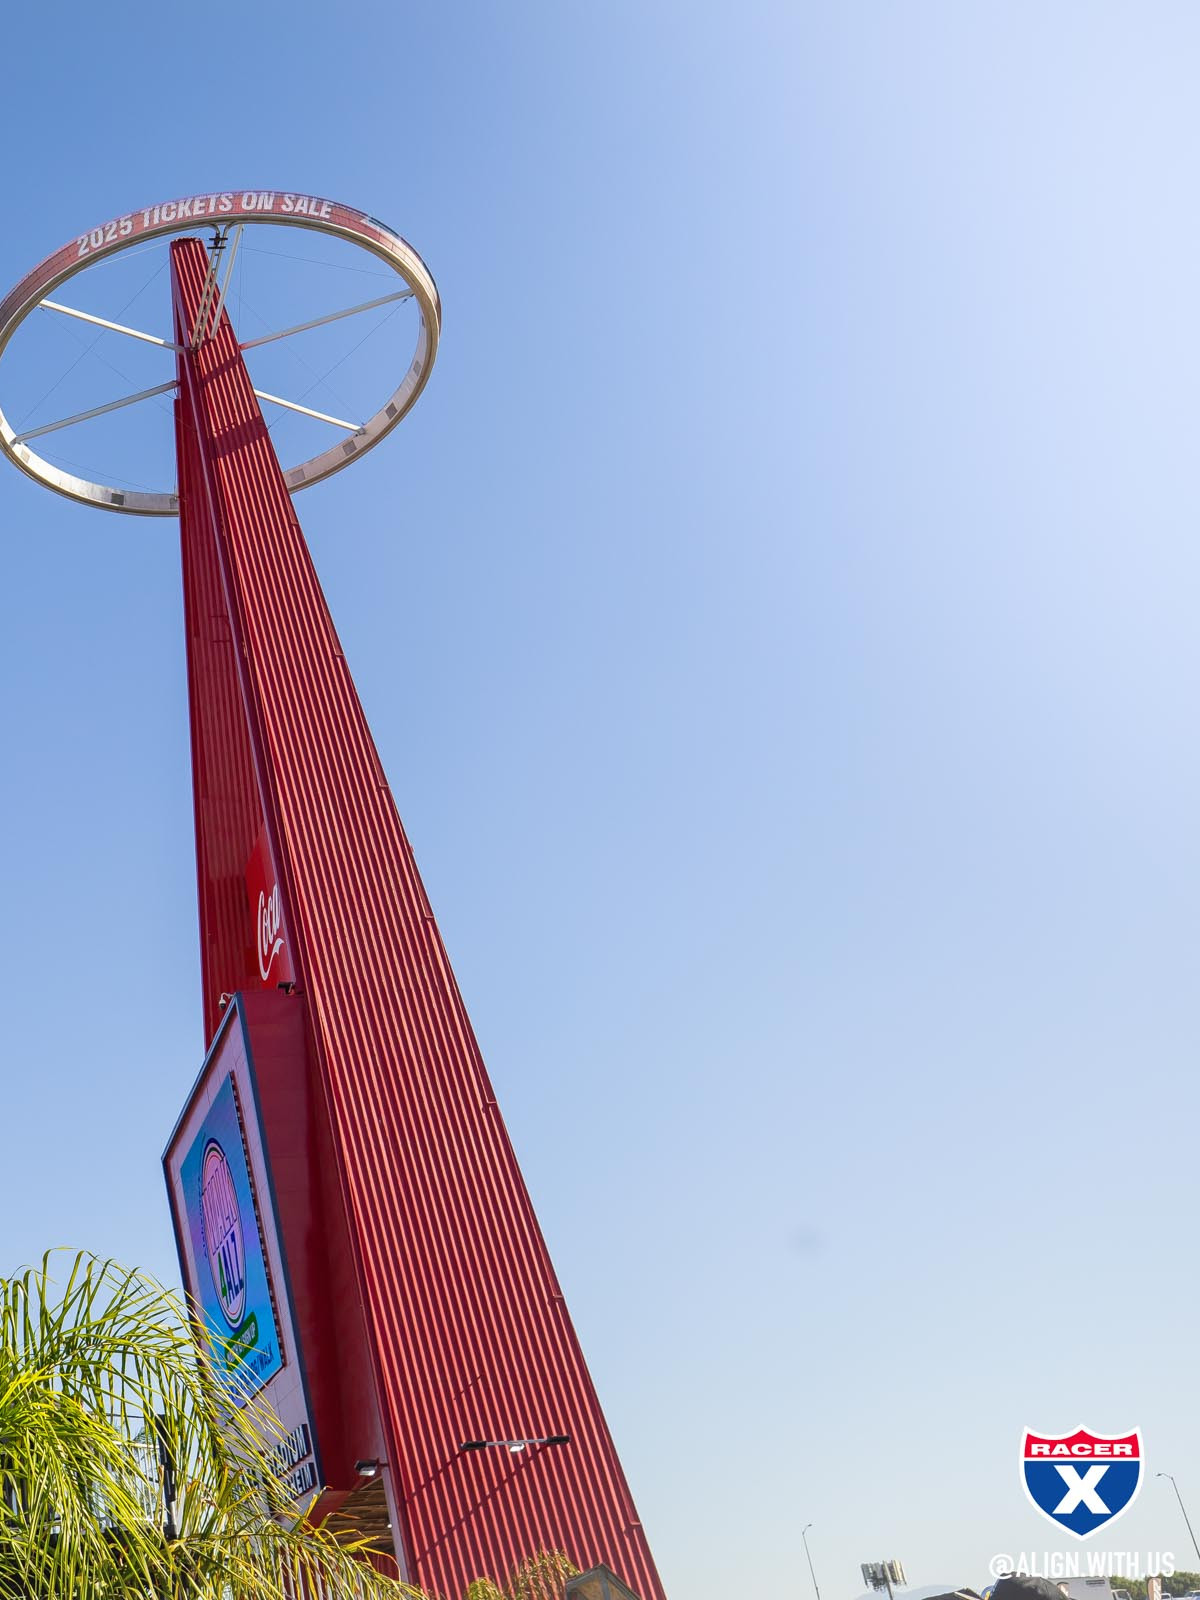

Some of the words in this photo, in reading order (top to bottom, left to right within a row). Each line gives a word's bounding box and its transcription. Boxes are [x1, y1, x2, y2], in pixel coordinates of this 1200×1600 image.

[76, 214, 133, 257] 2025
[141, 191, 234, 228] TICKETS
[241, 191, 275, 211] ON
[281, 193, 335, 219] SALE
